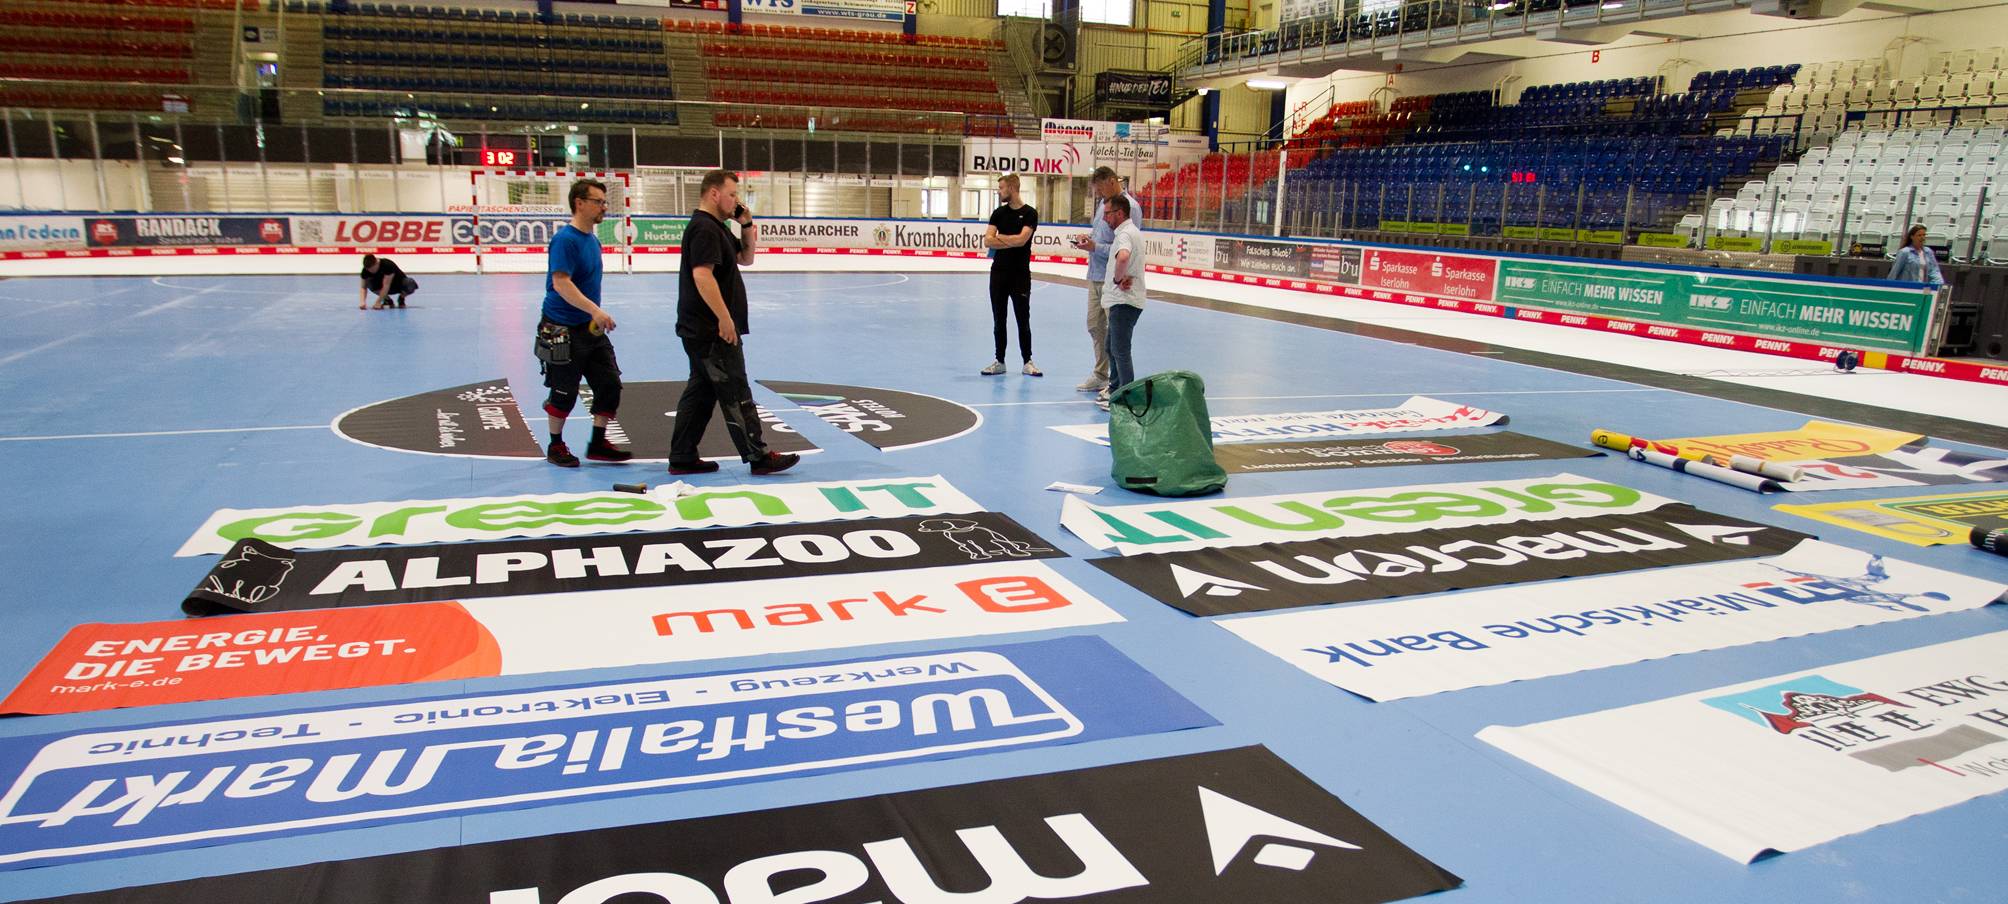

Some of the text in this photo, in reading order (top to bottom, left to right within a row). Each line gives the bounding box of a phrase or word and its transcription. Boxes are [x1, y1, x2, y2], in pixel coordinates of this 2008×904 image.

[1591, 51, 1600, 64] B
[973, 156, 1063, 174] RADIO MK
[135, 218, 222, 237] RANDACK
[335, 220, 444, 243] LOBBE
[643, 231, 684, 241] Hucksc
[761, 224, 859, 237] RAAB KARCHER
[895, 224, 985, 249] Krombacher
[1381, 261, 1418, 275] Sparkasse
[1445, 267, 1486, 282] Sparkasse
[1380, 276, 1410, 289] Iserlohn
[1443, 283, 1476, 297] Iserlohn
[1541, 279, 1582, 296] EINFACH
[1583, 284, 1616, 300] MEHR
[1618, 287, 1664, 305] WISSEN
[1740, 299, 1797, 320] EINFACH
[1799, 304, 1845, 325] MEHR
[1849, 309, 1913, 333] WISSEN
[1758, 322, 1820, 336] www.ikz-online.de
[818, 482, 938, 512] IT
[1102, 509, 1232, 544] IT
[309, 529, 920, 595] ALPHAZOO
[651, 590, 948, 637] mark
[85, 625, 328, 656] ENERGIE,
[1302, 590, 1770, 668] Märkische Bank
[64, 639, 416, 681] DIE BEWEGT.
[50, 676, 183, 695] mark-e.de
[88, 659, 979, 756] Werkzeug Elektronic Technic
[495, 686, 1016, 777] Westfalia
